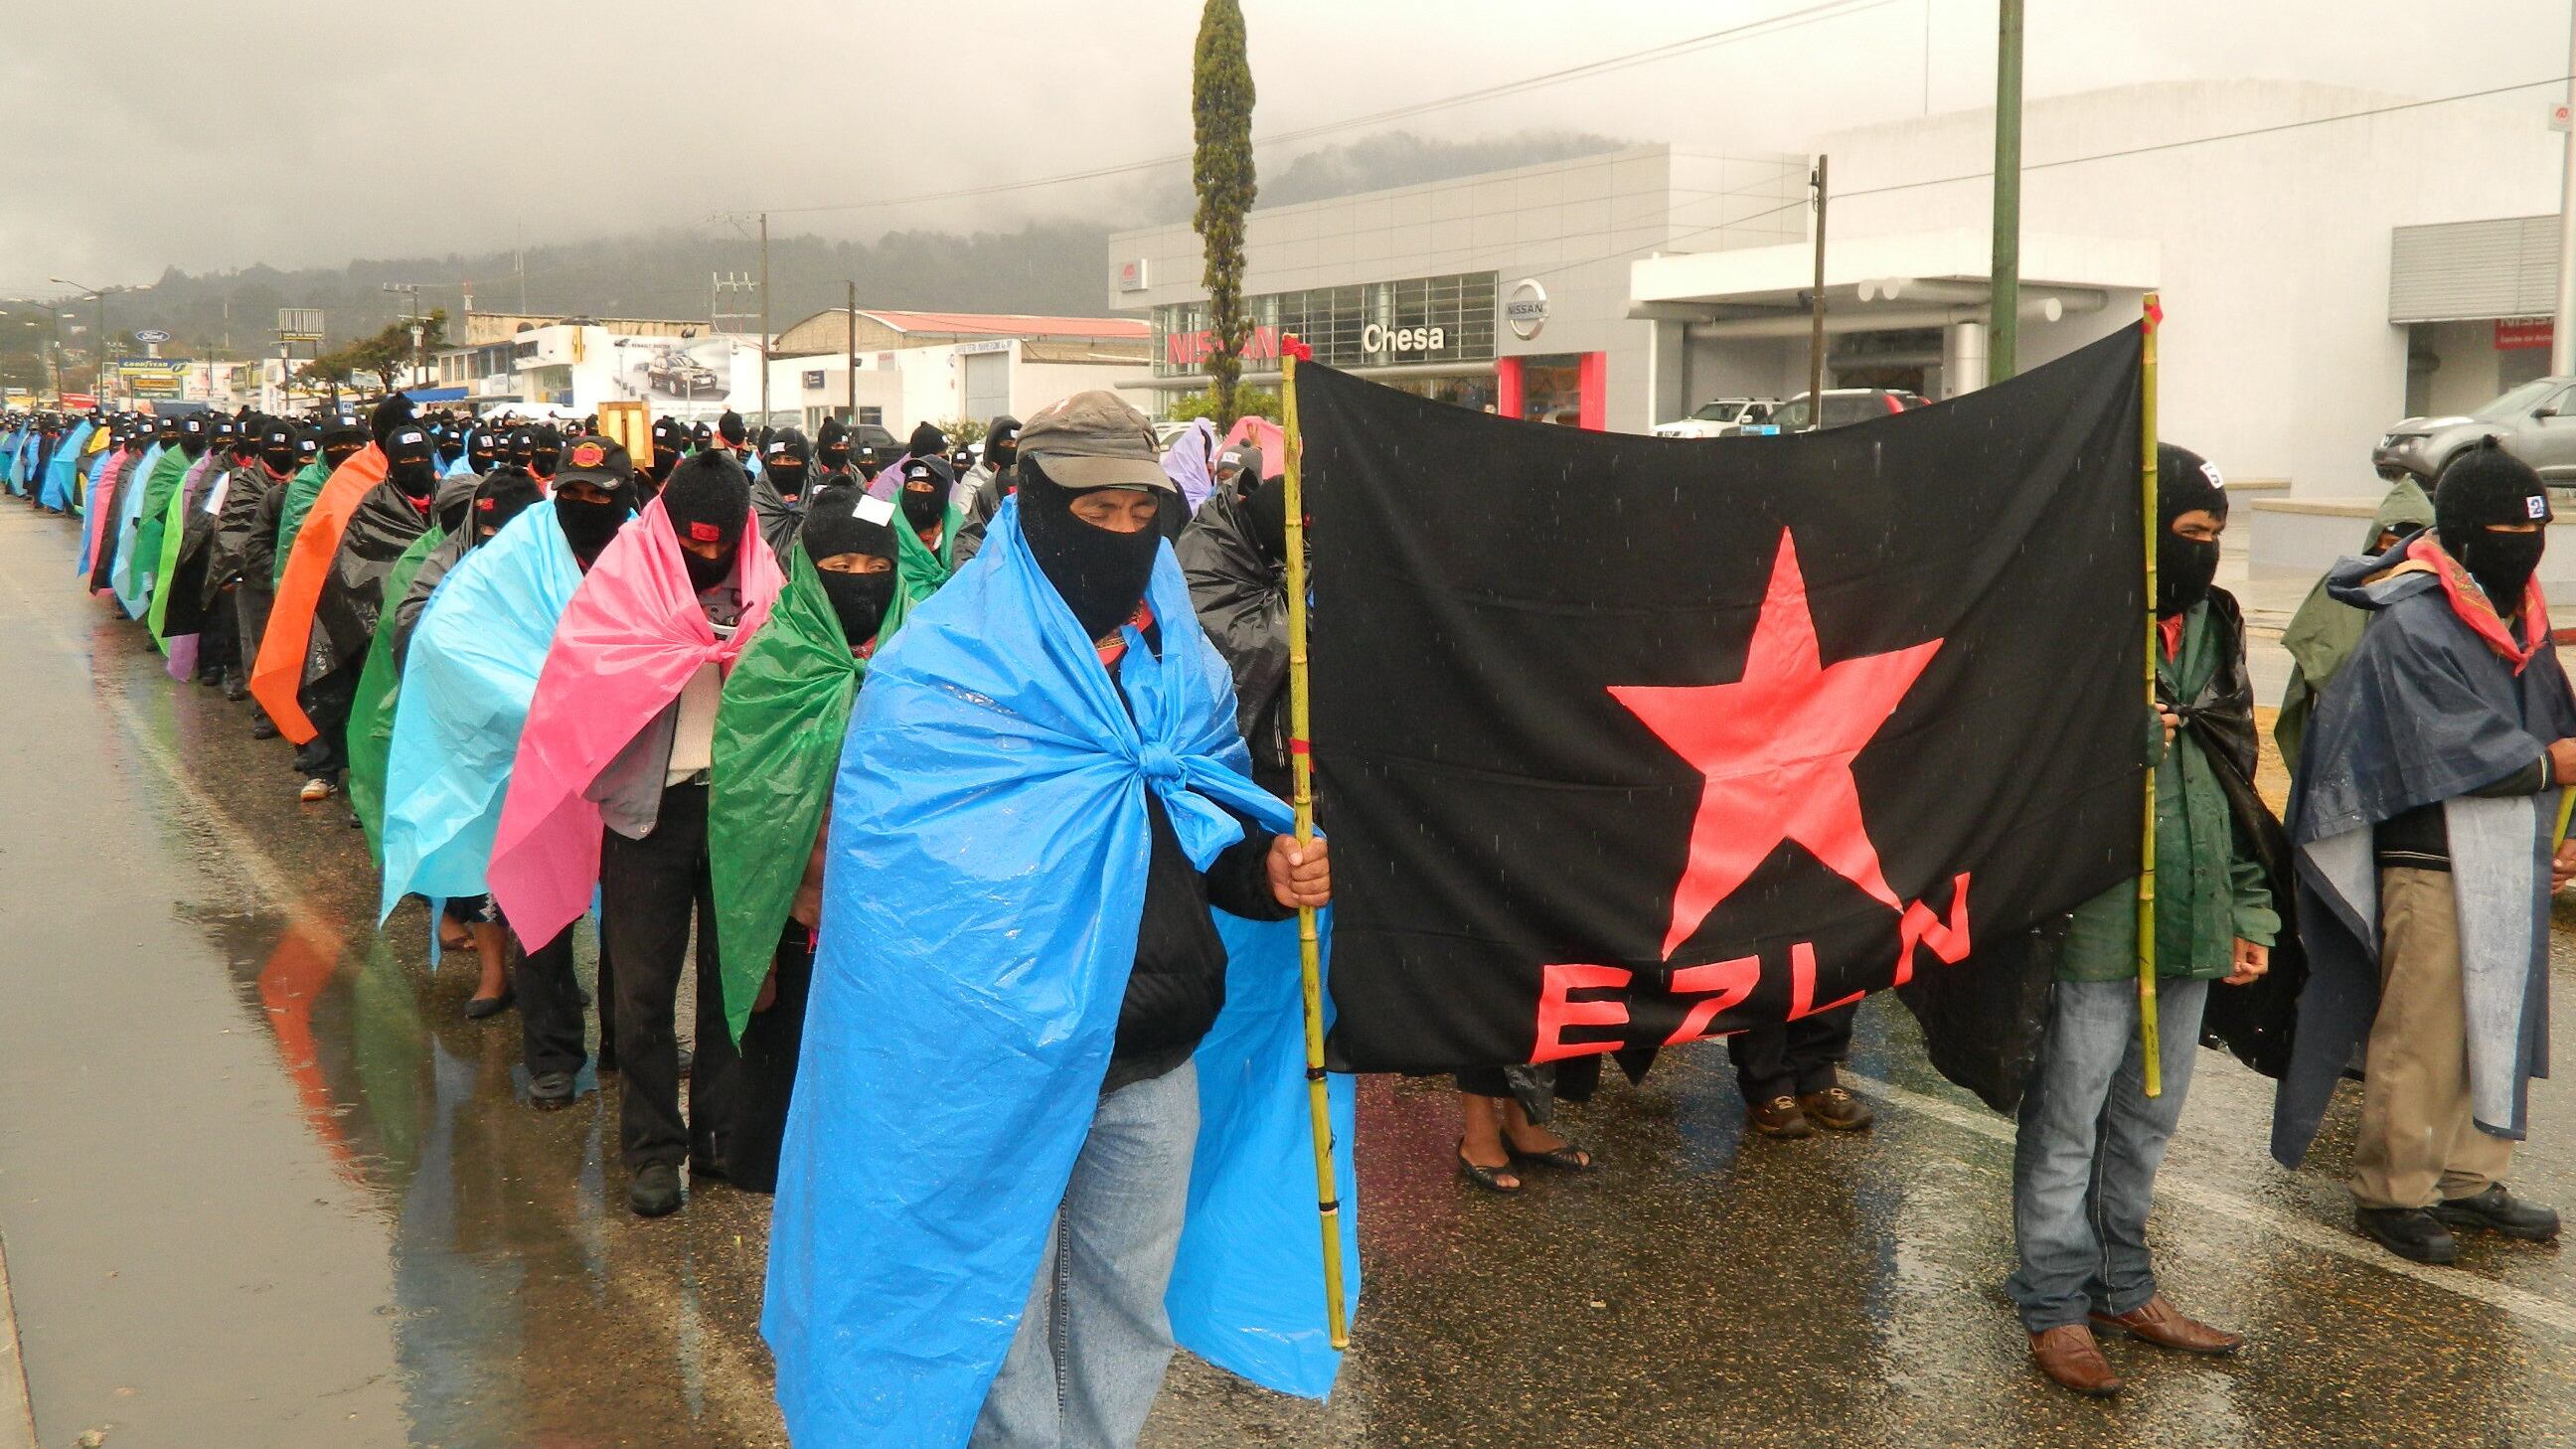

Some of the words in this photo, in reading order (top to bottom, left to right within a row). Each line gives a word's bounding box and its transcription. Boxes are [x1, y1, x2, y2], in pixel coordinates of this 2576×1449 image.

[1508, 304, 1543, 315] NISSAN
[1169, 326, 1278, 366] NISAN
[1364, 323, 1444, 353] Chesa
[2530, 499, 2542, 515] 2
[1529, 872, 1971, 1064] EZLN
